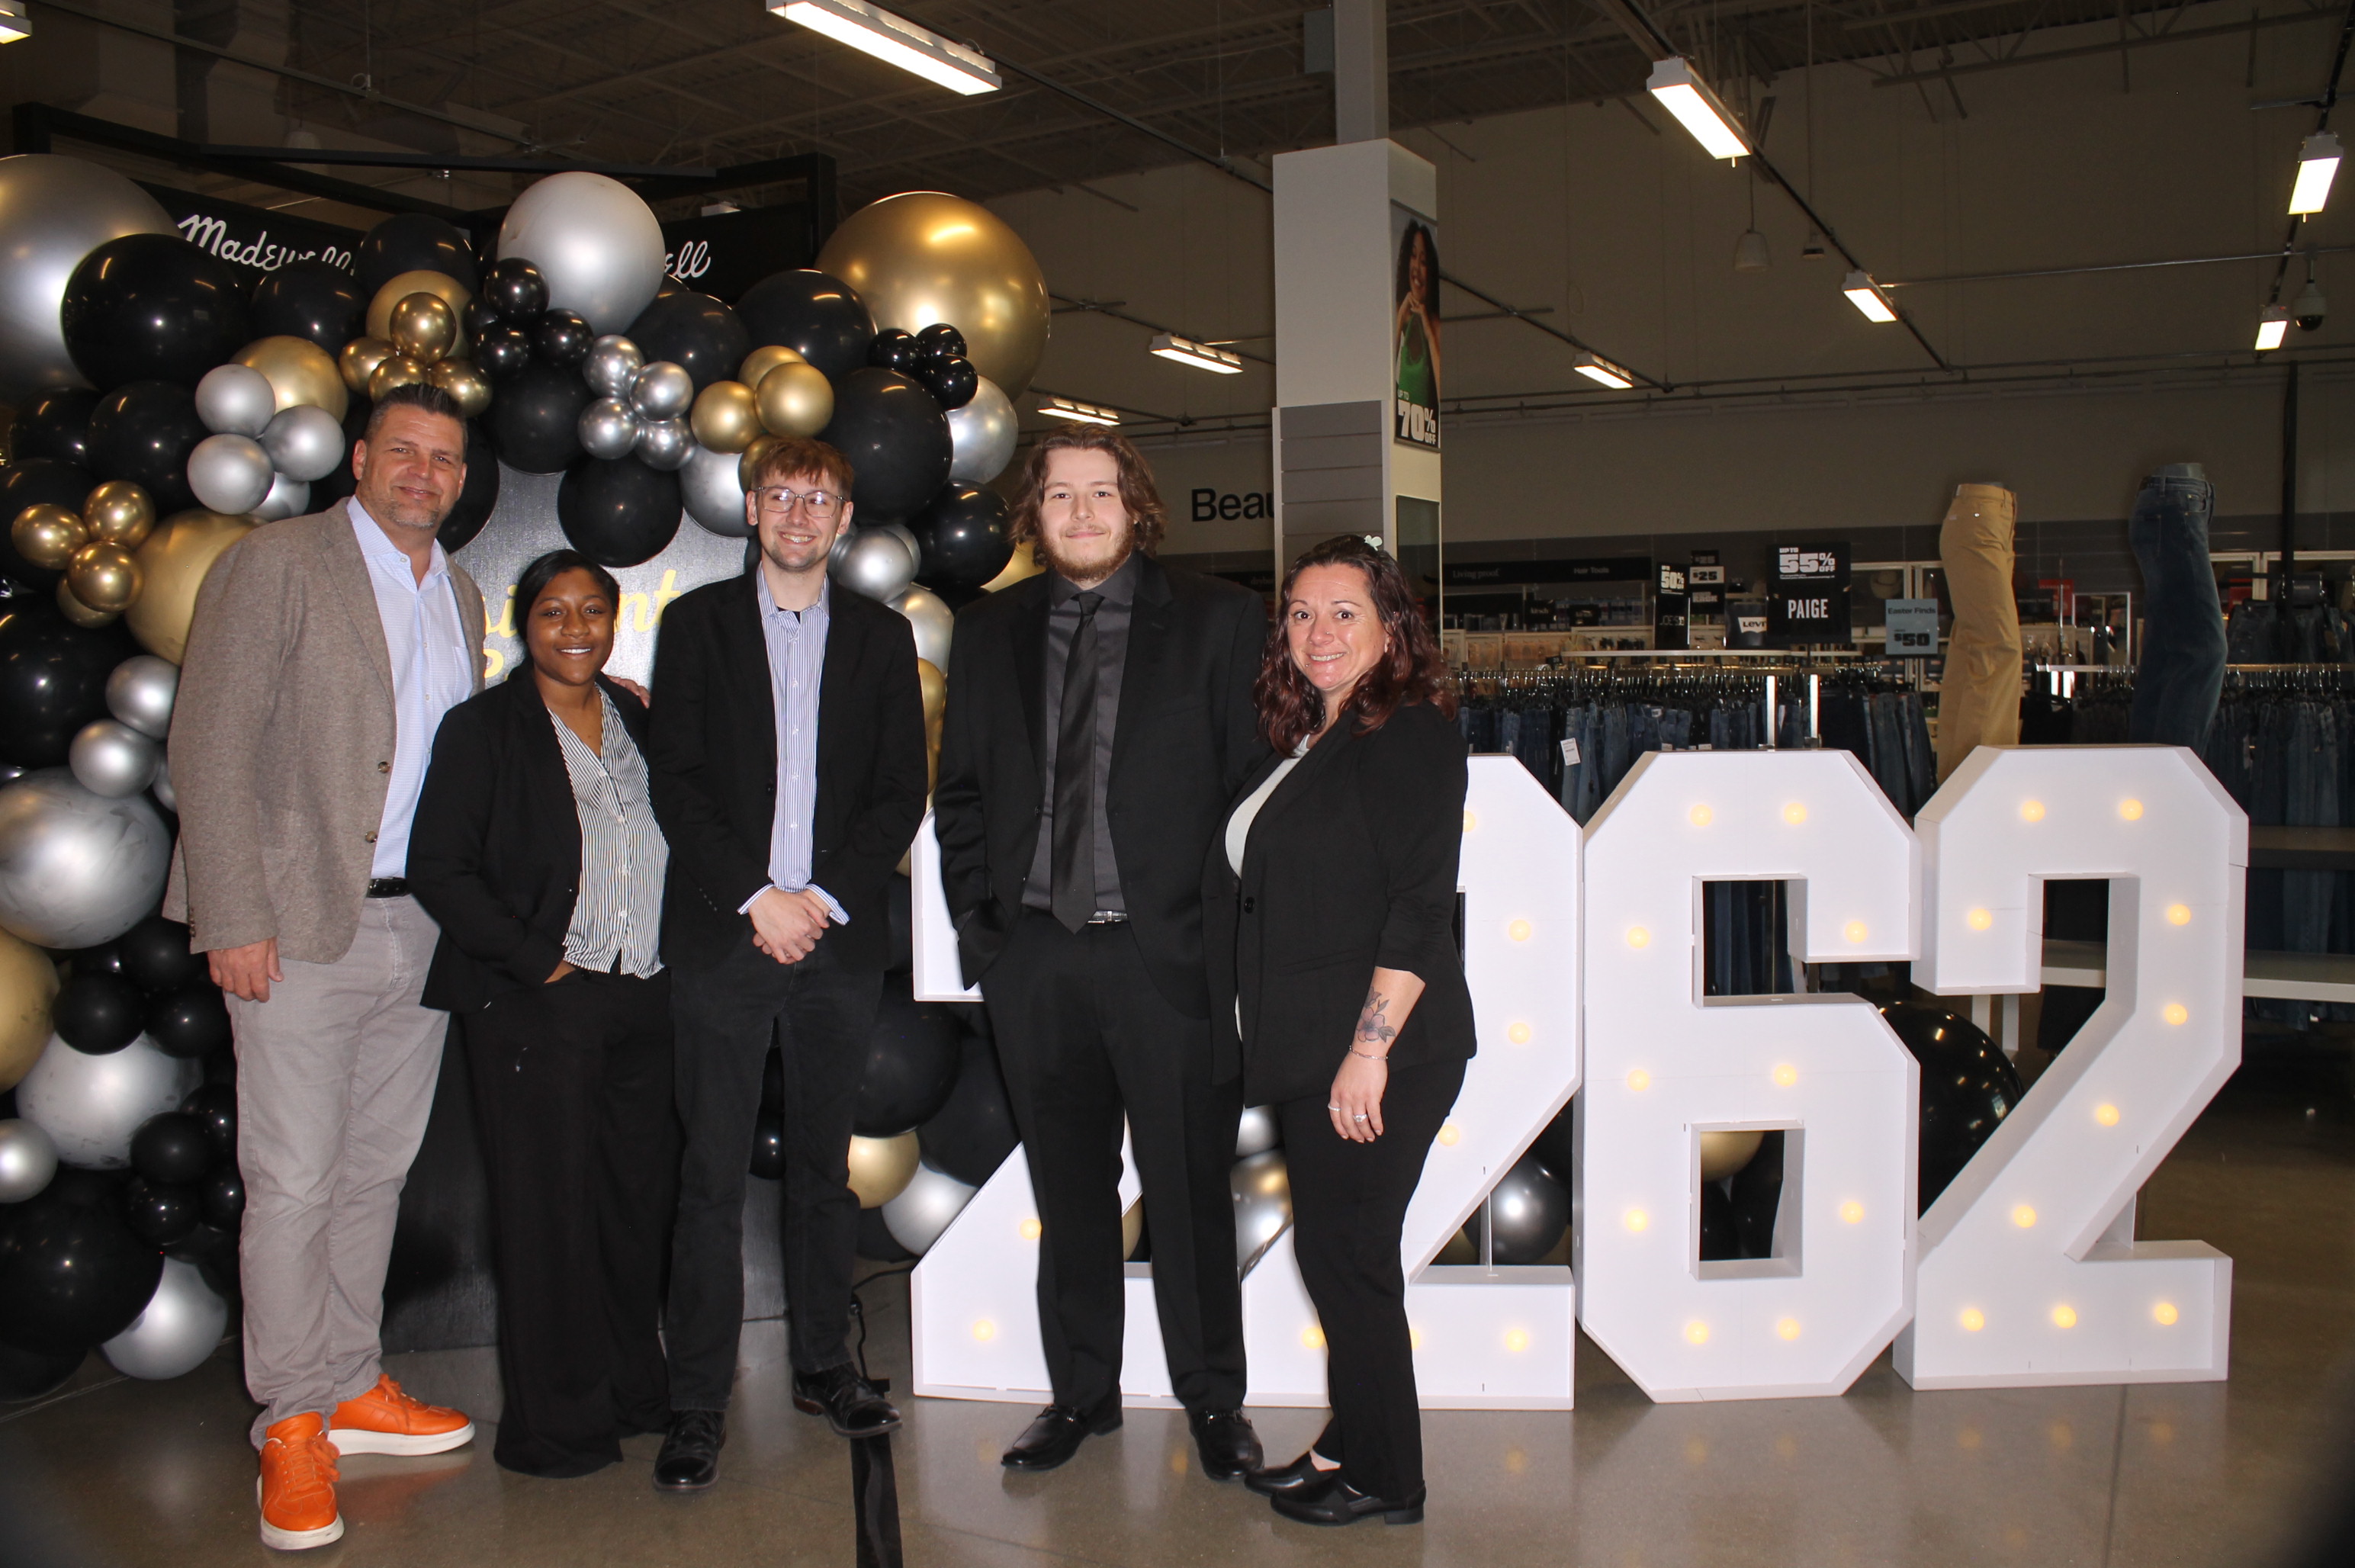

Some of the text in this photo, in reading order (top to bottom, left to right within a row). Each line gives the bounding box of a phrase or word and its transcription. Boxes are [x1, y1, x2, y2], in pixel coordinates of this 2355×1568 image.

[1398, 399, 1436, 442] 70%
[1425, 432, 1436, 445] OFF
[1779, 552, 1836, 574] 55%
[1661, 570, 1685, 589] 50%
[1693, 571, 1717, 580] $25
[1788, 598, 1829, 619] PAIGE
[1894, 633, 1930, 647] $50
